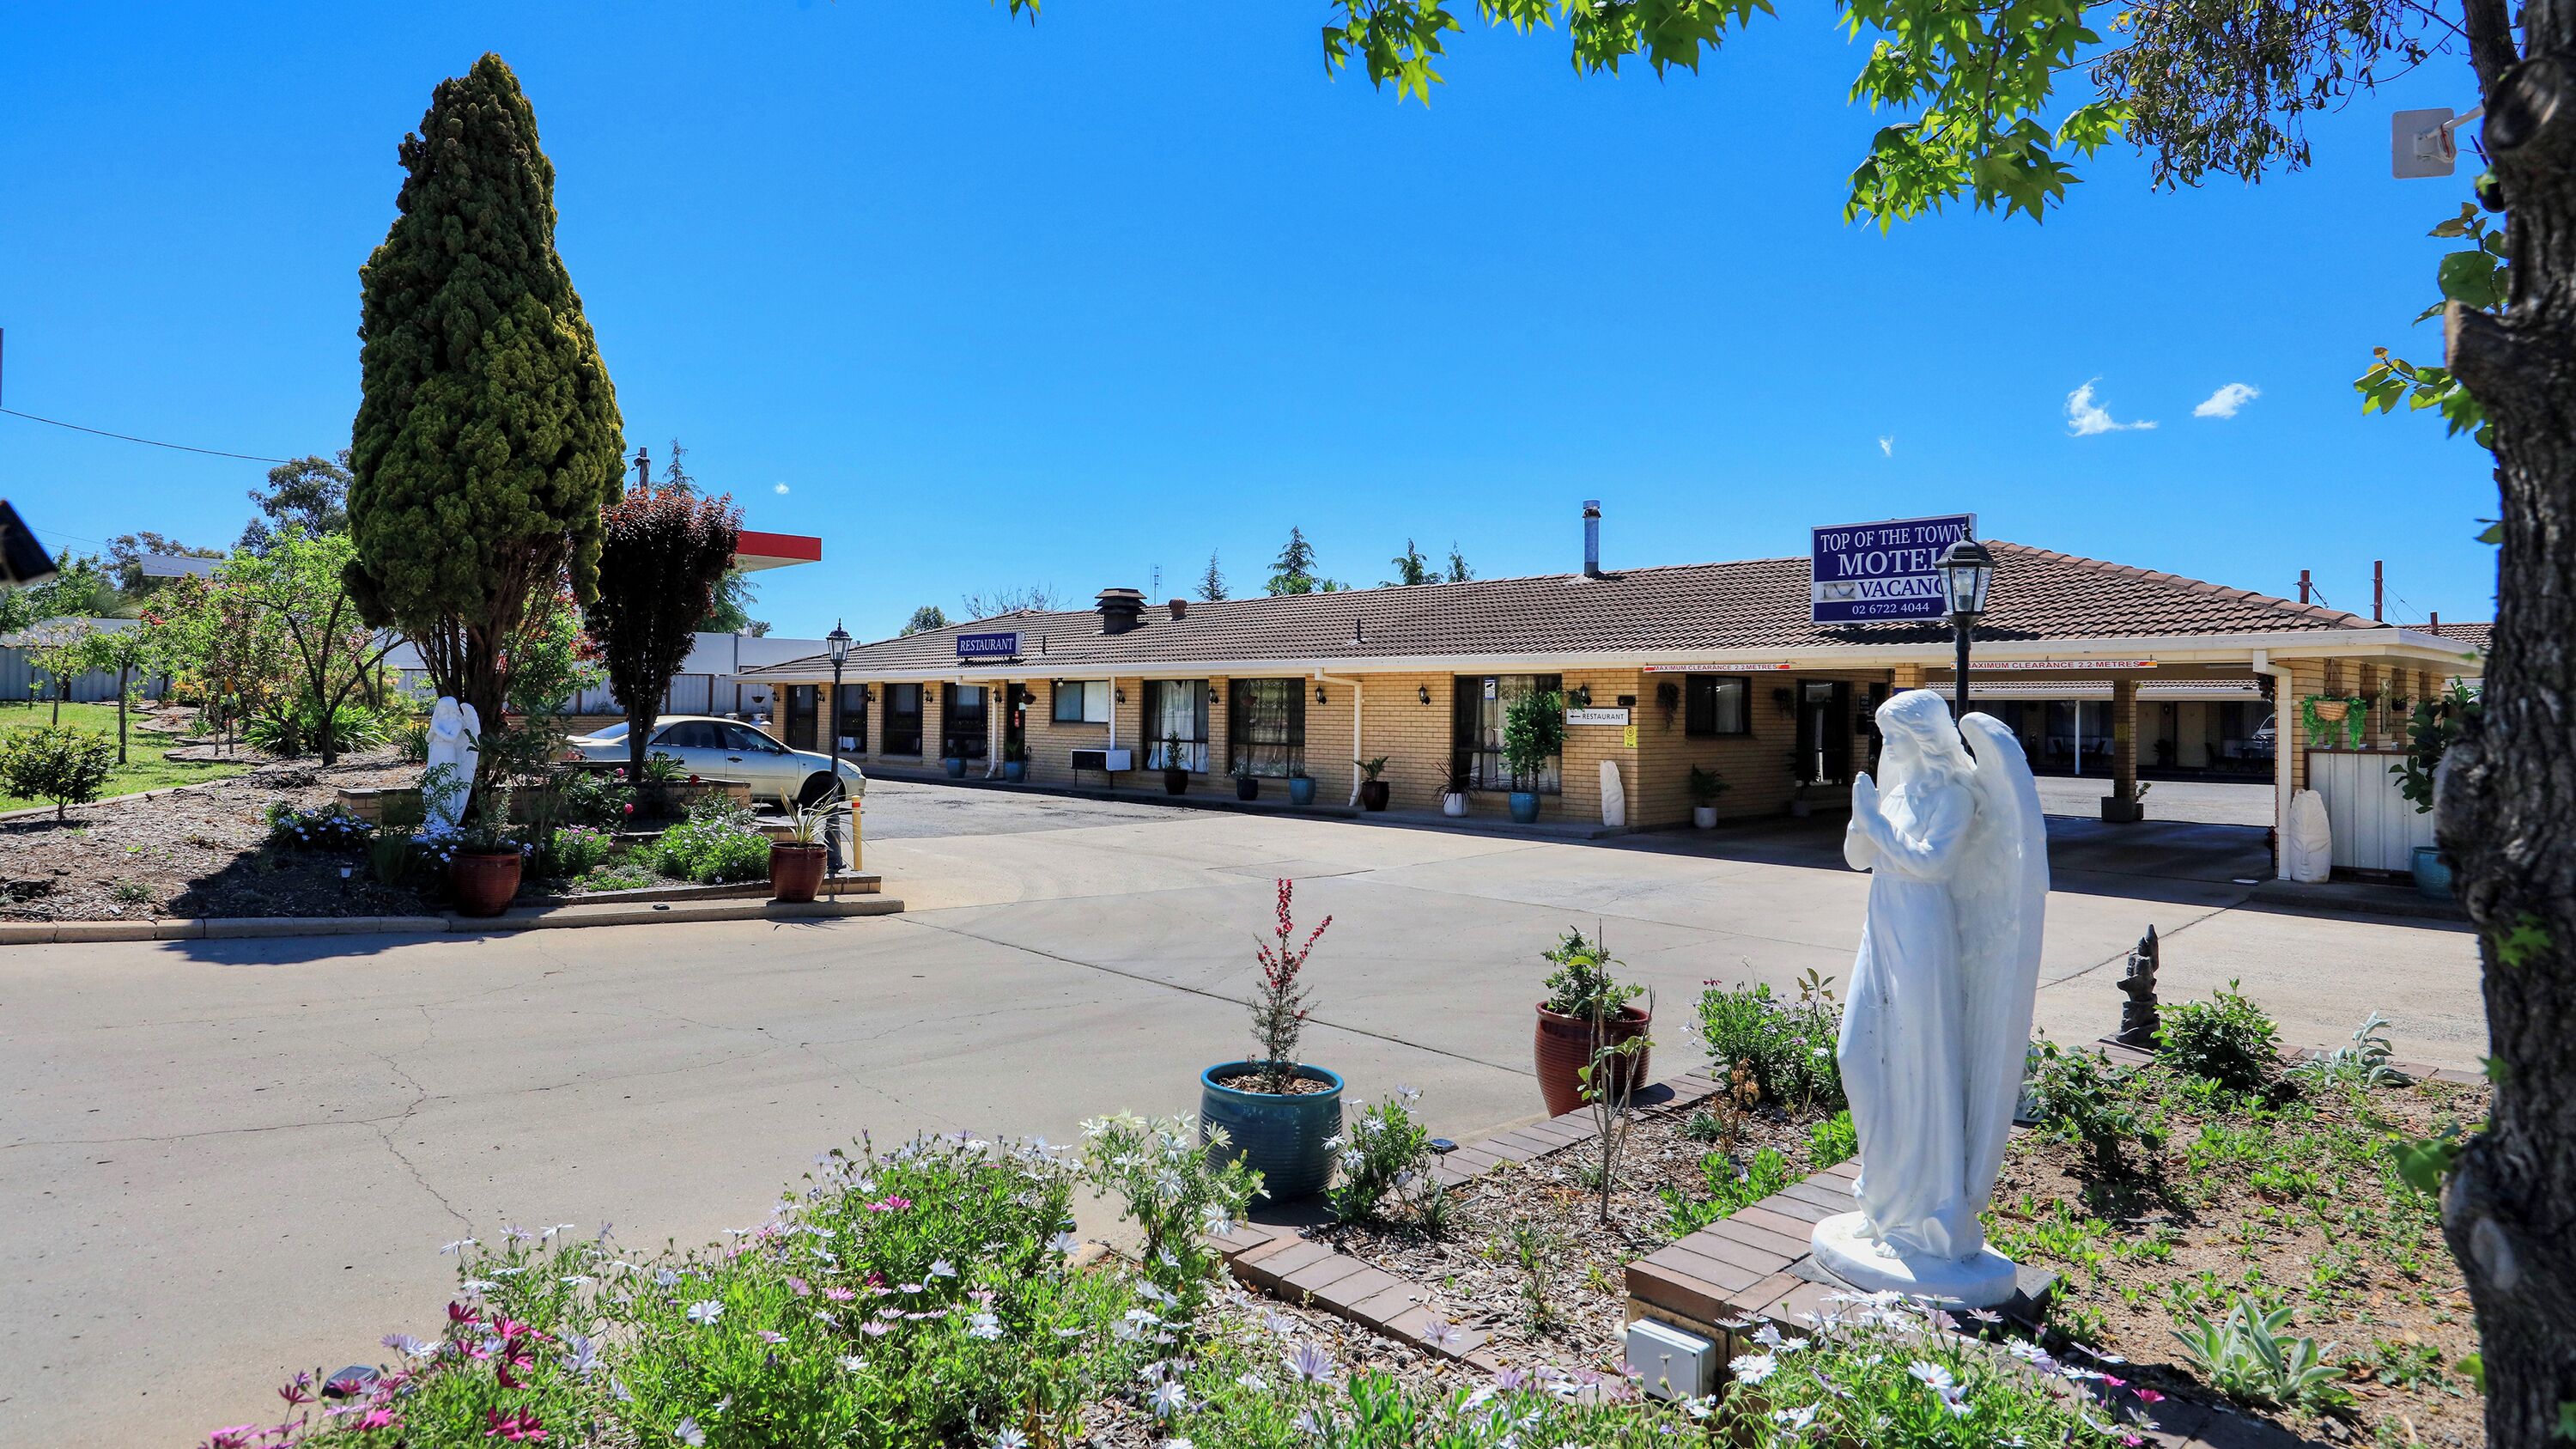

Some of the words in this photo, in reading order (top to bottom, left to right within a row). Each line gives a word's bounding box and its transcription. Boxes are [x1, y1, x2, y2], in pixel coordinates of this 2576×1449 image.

[1820, 533, 1850, 553] TOP
[1854, 531, 1874, 548] OF
[1879, 527, 1911, 545] THE
[1915, 523, 1966, 544] TOWN
[1858, 578, 1947, 598] VACANC
[1852, 605, 1866, 615] 02
[1869, 604, 1897, 614] 6722
[1900, 602, 1930, 612] 4044
[960, 638, 1013, 652] RESTAURANT
